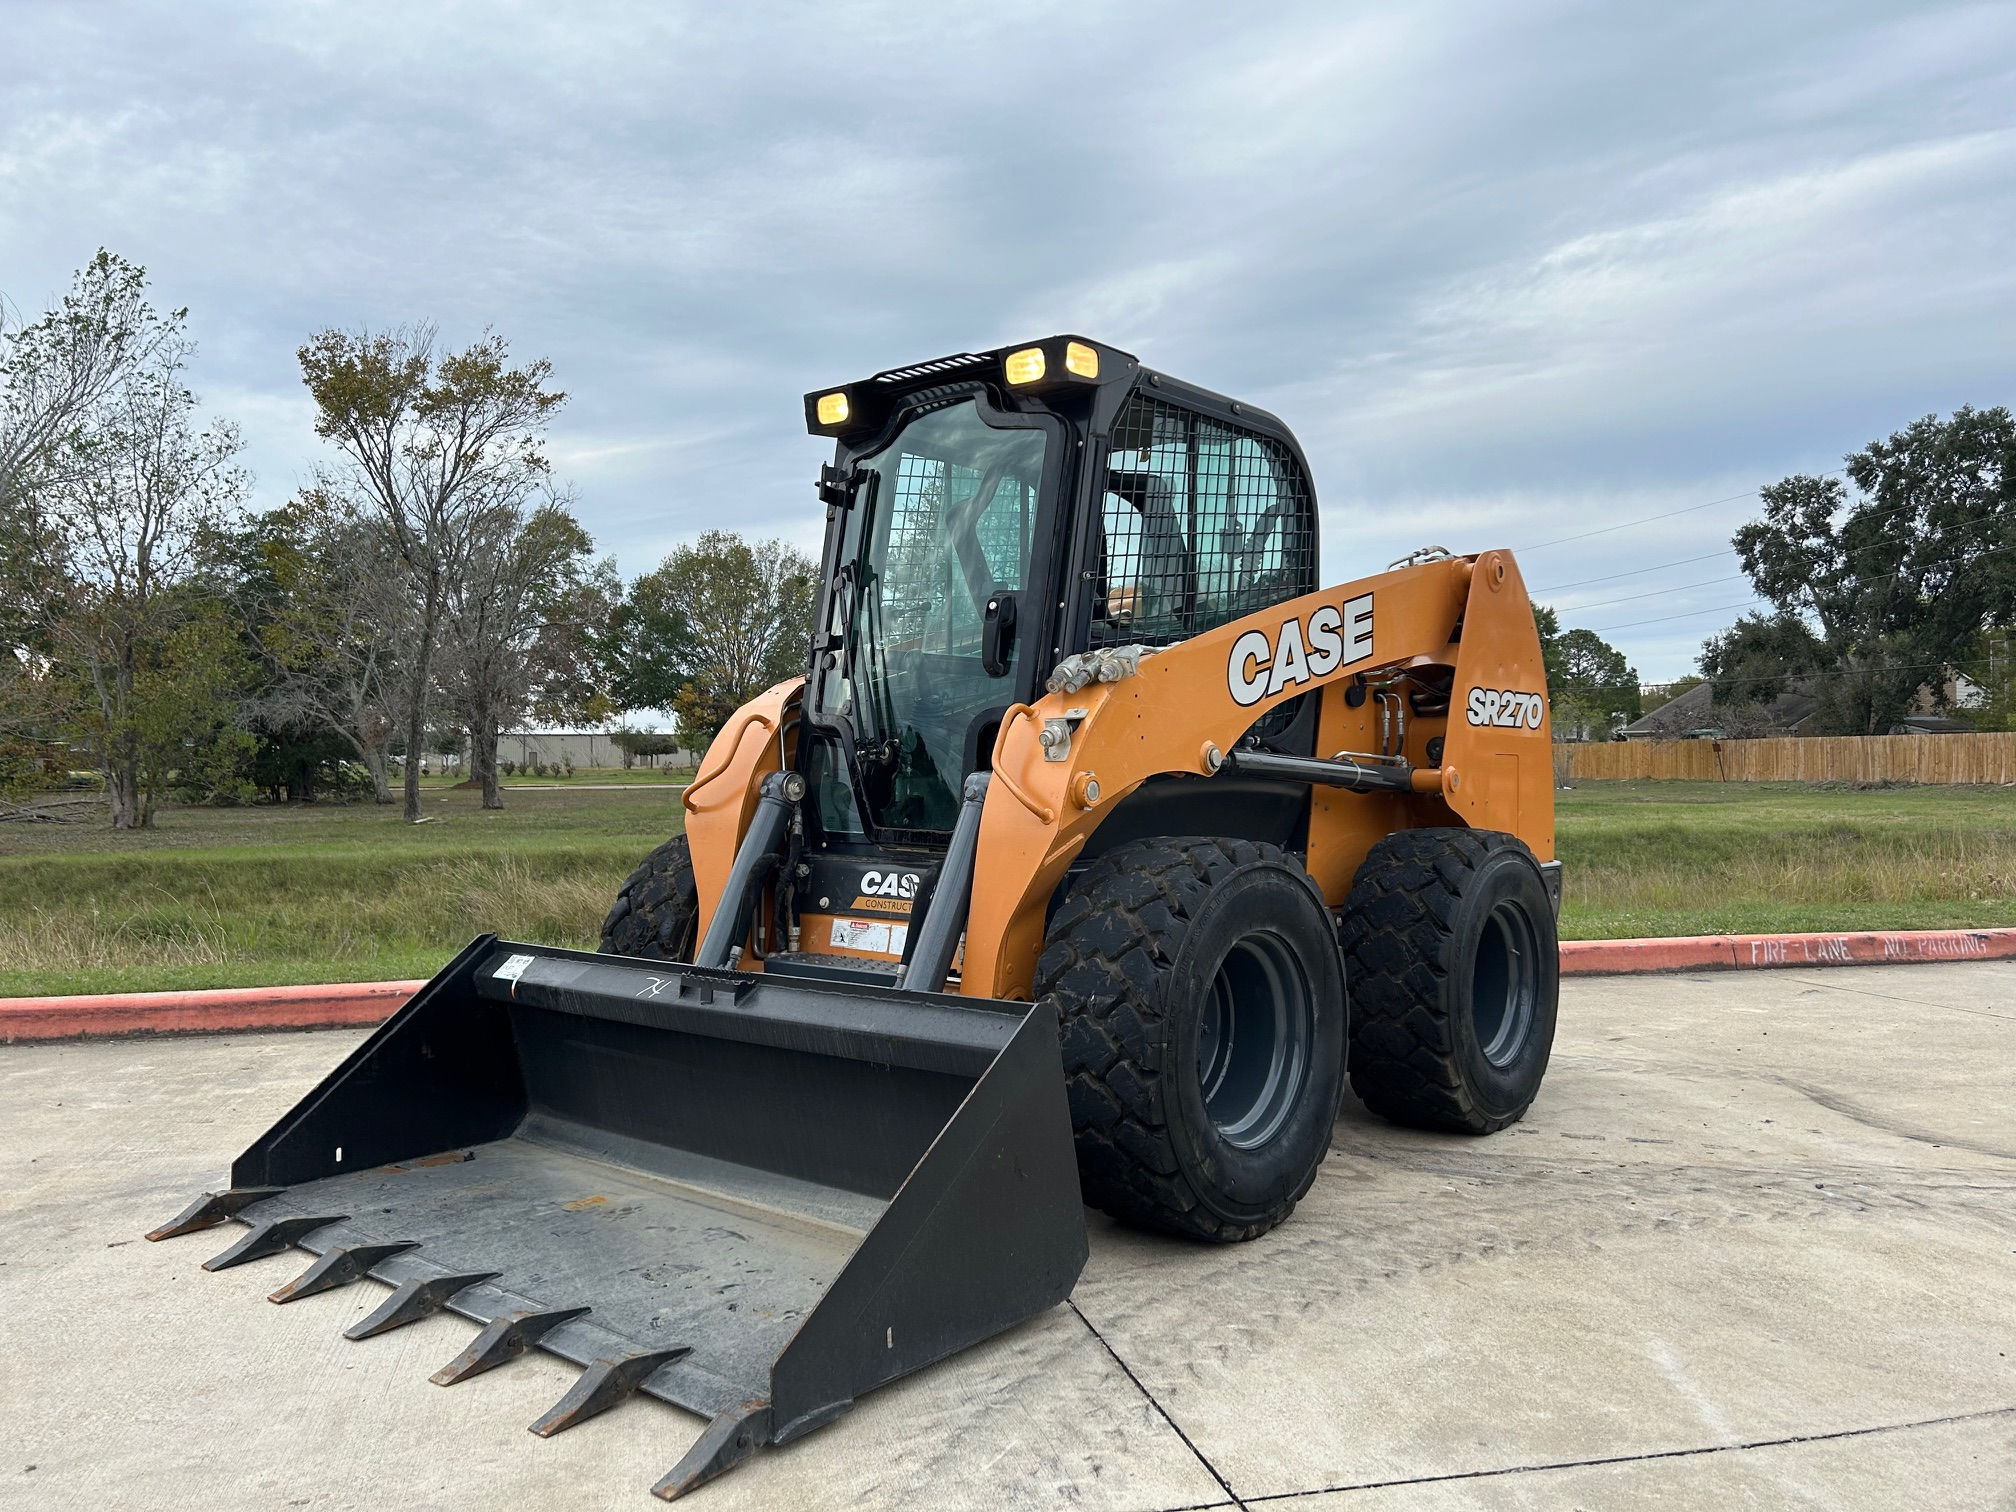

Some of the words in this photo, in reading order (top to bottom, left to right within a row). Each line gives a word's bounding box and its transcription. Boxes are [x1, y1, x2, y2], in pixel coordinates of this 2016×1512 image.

[1227, 592, 1375, 707] CASE
[1466, 686, 1544, 730] SR270
[860, 870, 936, 900] CAS
[865, 899, 913, 912] CONSTRUCT
[1751, 939, 1789, 965] FIRE
[1803, 937, 1854, 963] LANE
[1917, 933, 1987, 956] PARKING
